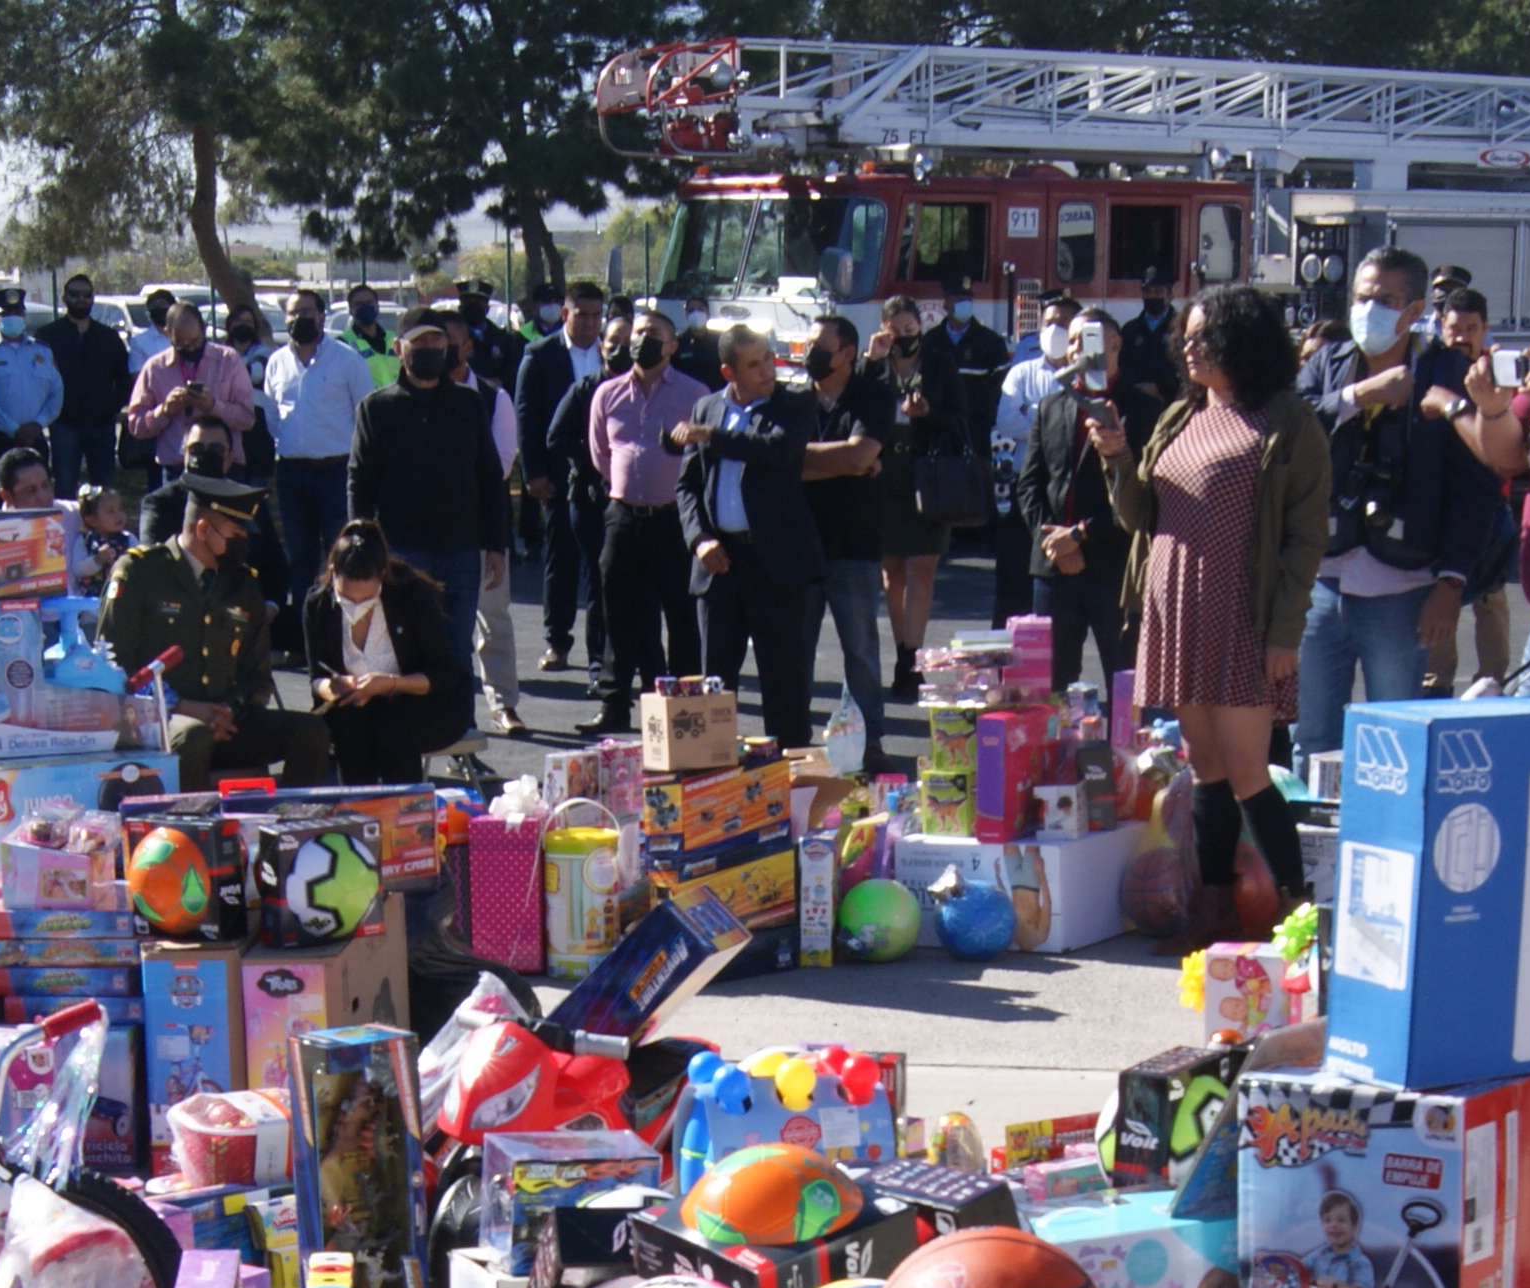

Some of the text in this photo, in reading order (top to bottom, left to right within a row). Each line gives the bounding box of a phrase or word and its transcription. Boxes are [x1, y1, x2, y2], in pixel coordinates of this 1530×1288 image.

[881, 128, 928, 145] 75 FT
[1009, 211, 1039, 228] 911
[8, 737, 48, 751] Deluxe
[1353, 767, 1408, 796] MOLTO
[1434, 770, 1492, 795] MOLTO
[1328, 1034, 1368, 1059] MOLTO
[1119, 1132, 1159, 1151] Voit
